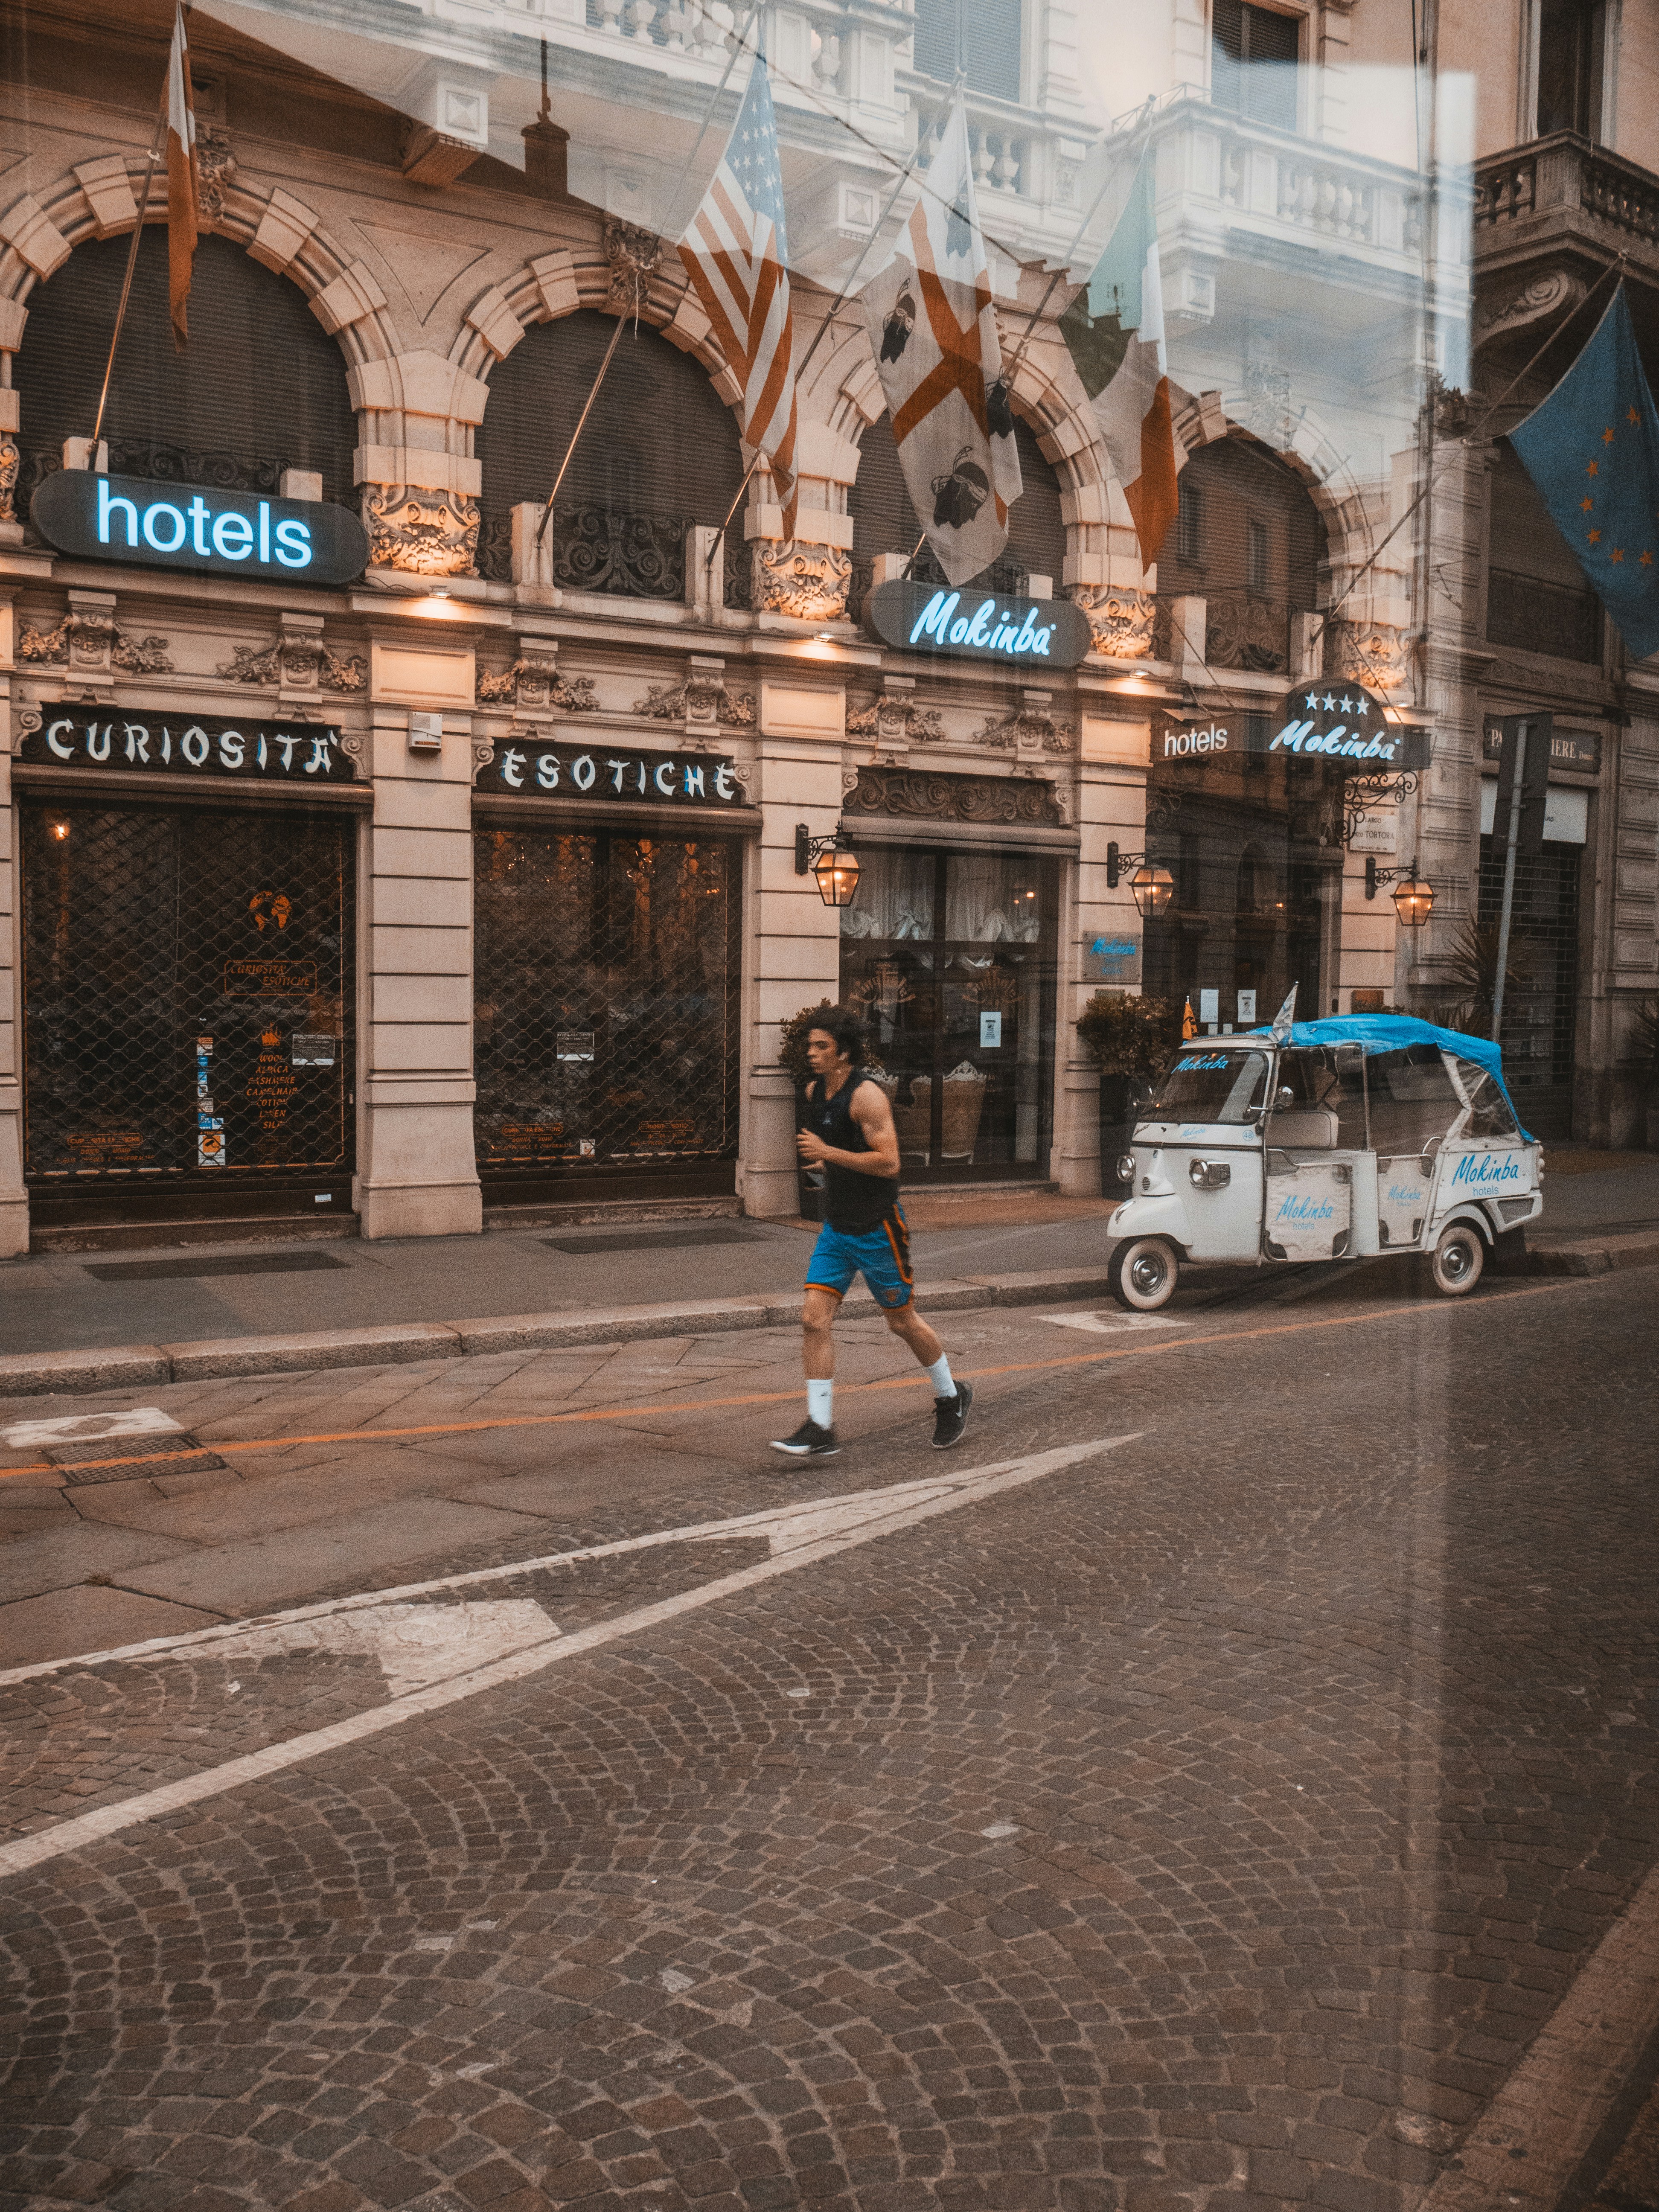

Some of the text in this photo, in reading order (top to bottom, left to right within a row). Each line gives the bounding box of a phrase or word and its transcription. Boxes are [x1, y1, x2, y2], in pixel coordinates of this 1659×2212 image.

[97, 479, 312, 568] hotels
[909, 591, 1050, 656] Mokinba
[1164, 724, 1228, 757] hotels
[501, 748, 736, 800] ESOTICHE
[1366, 831, 1394, 839] TORTORA
[1171, 1054, 1228, 1074] Mokinba
[1452, 1154, 1519, 1187] Mokinba
[1473, 1185, 1499, 1196] hotels
[1275, 1195, 1333, 1221] Mokinba
[1293, 1221, 1315, 1230] hotels
